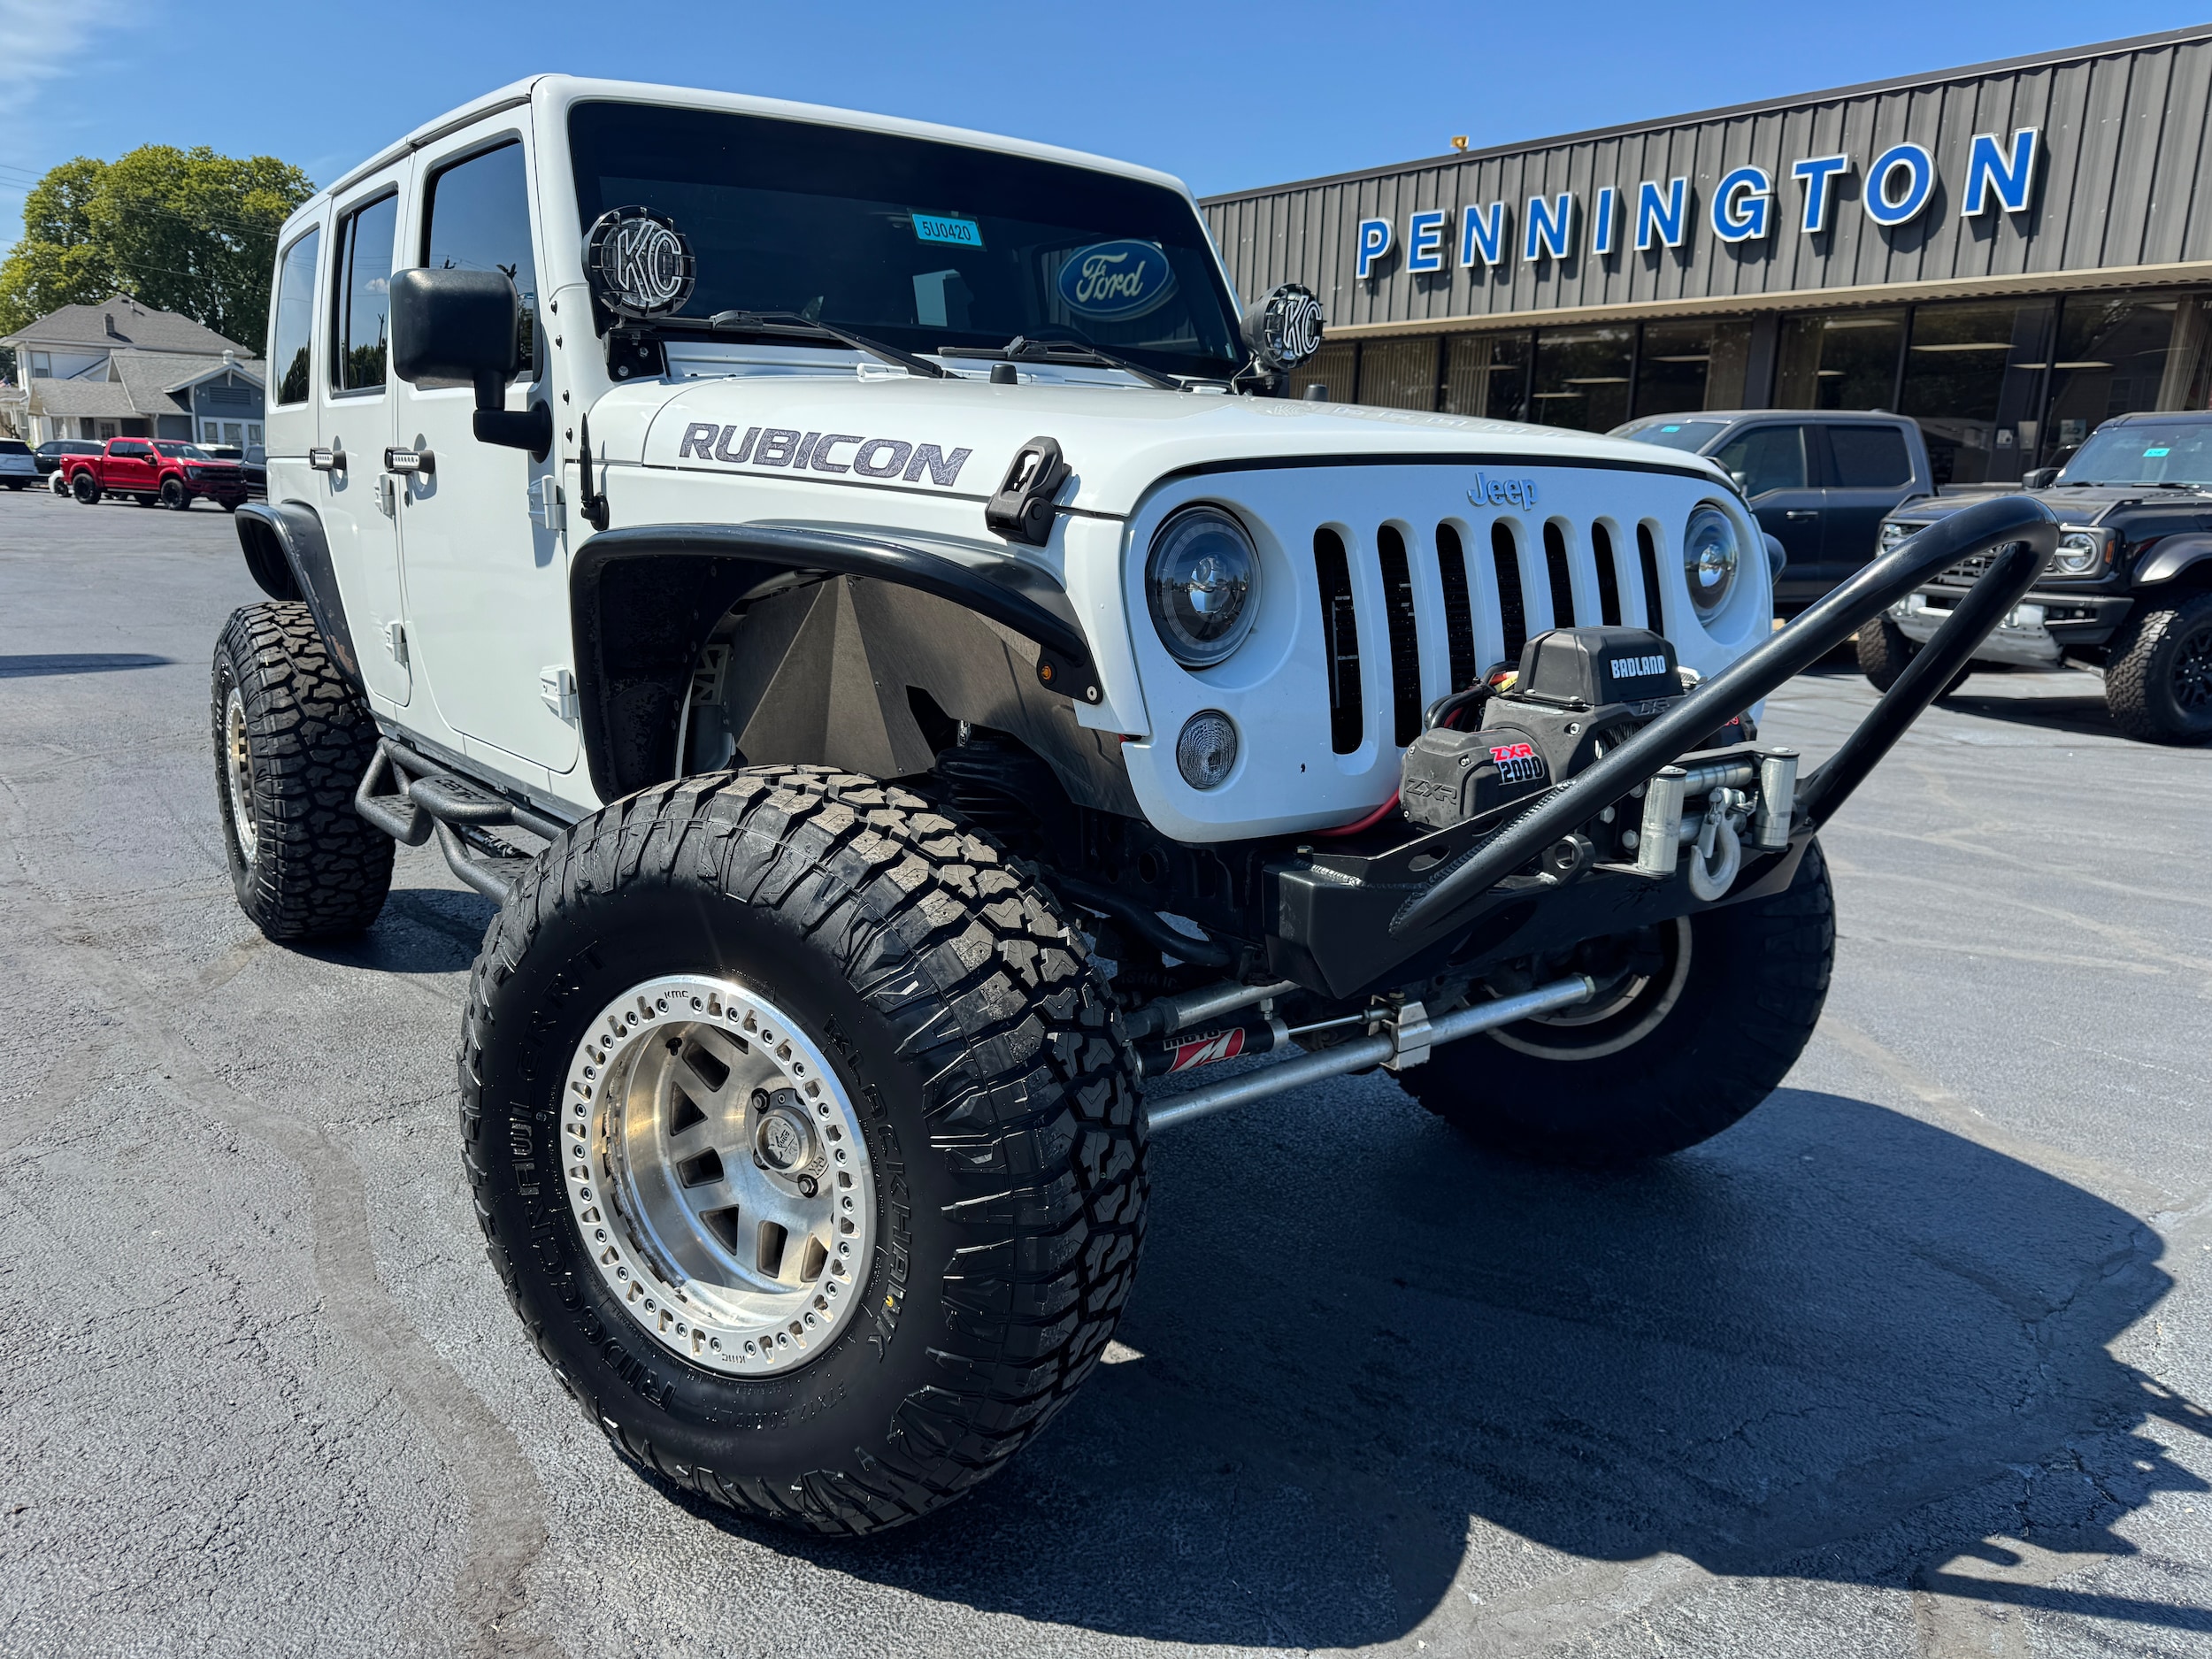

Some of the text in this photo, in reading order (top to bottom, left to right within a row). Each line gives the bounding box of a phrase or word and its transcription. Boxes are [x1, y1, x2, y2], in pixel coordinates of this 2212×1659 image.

[1355, 126, 2040, 280] PENNINGTON
[921, 220, 972, 242] 5U0420
[617, 220, 682, 303] KC
[1075, 251, 1146, 303] Ford
[1282, 295, 1323, 357] KC
[678, 421, 973, 488] RUBICON
[1466, 471, 1539, 511] Jeep
[1610, 655, 1667, 680] BADLAND
[1489, 742, 1534, 764] ZXR
[1497, 756, 1545, 787] 12000
[1405, 777, 1458, 807] ZXR
[664, 989, 689, 1000] KMC
[822, 1015, 913, 1363] BLACKHAWK
